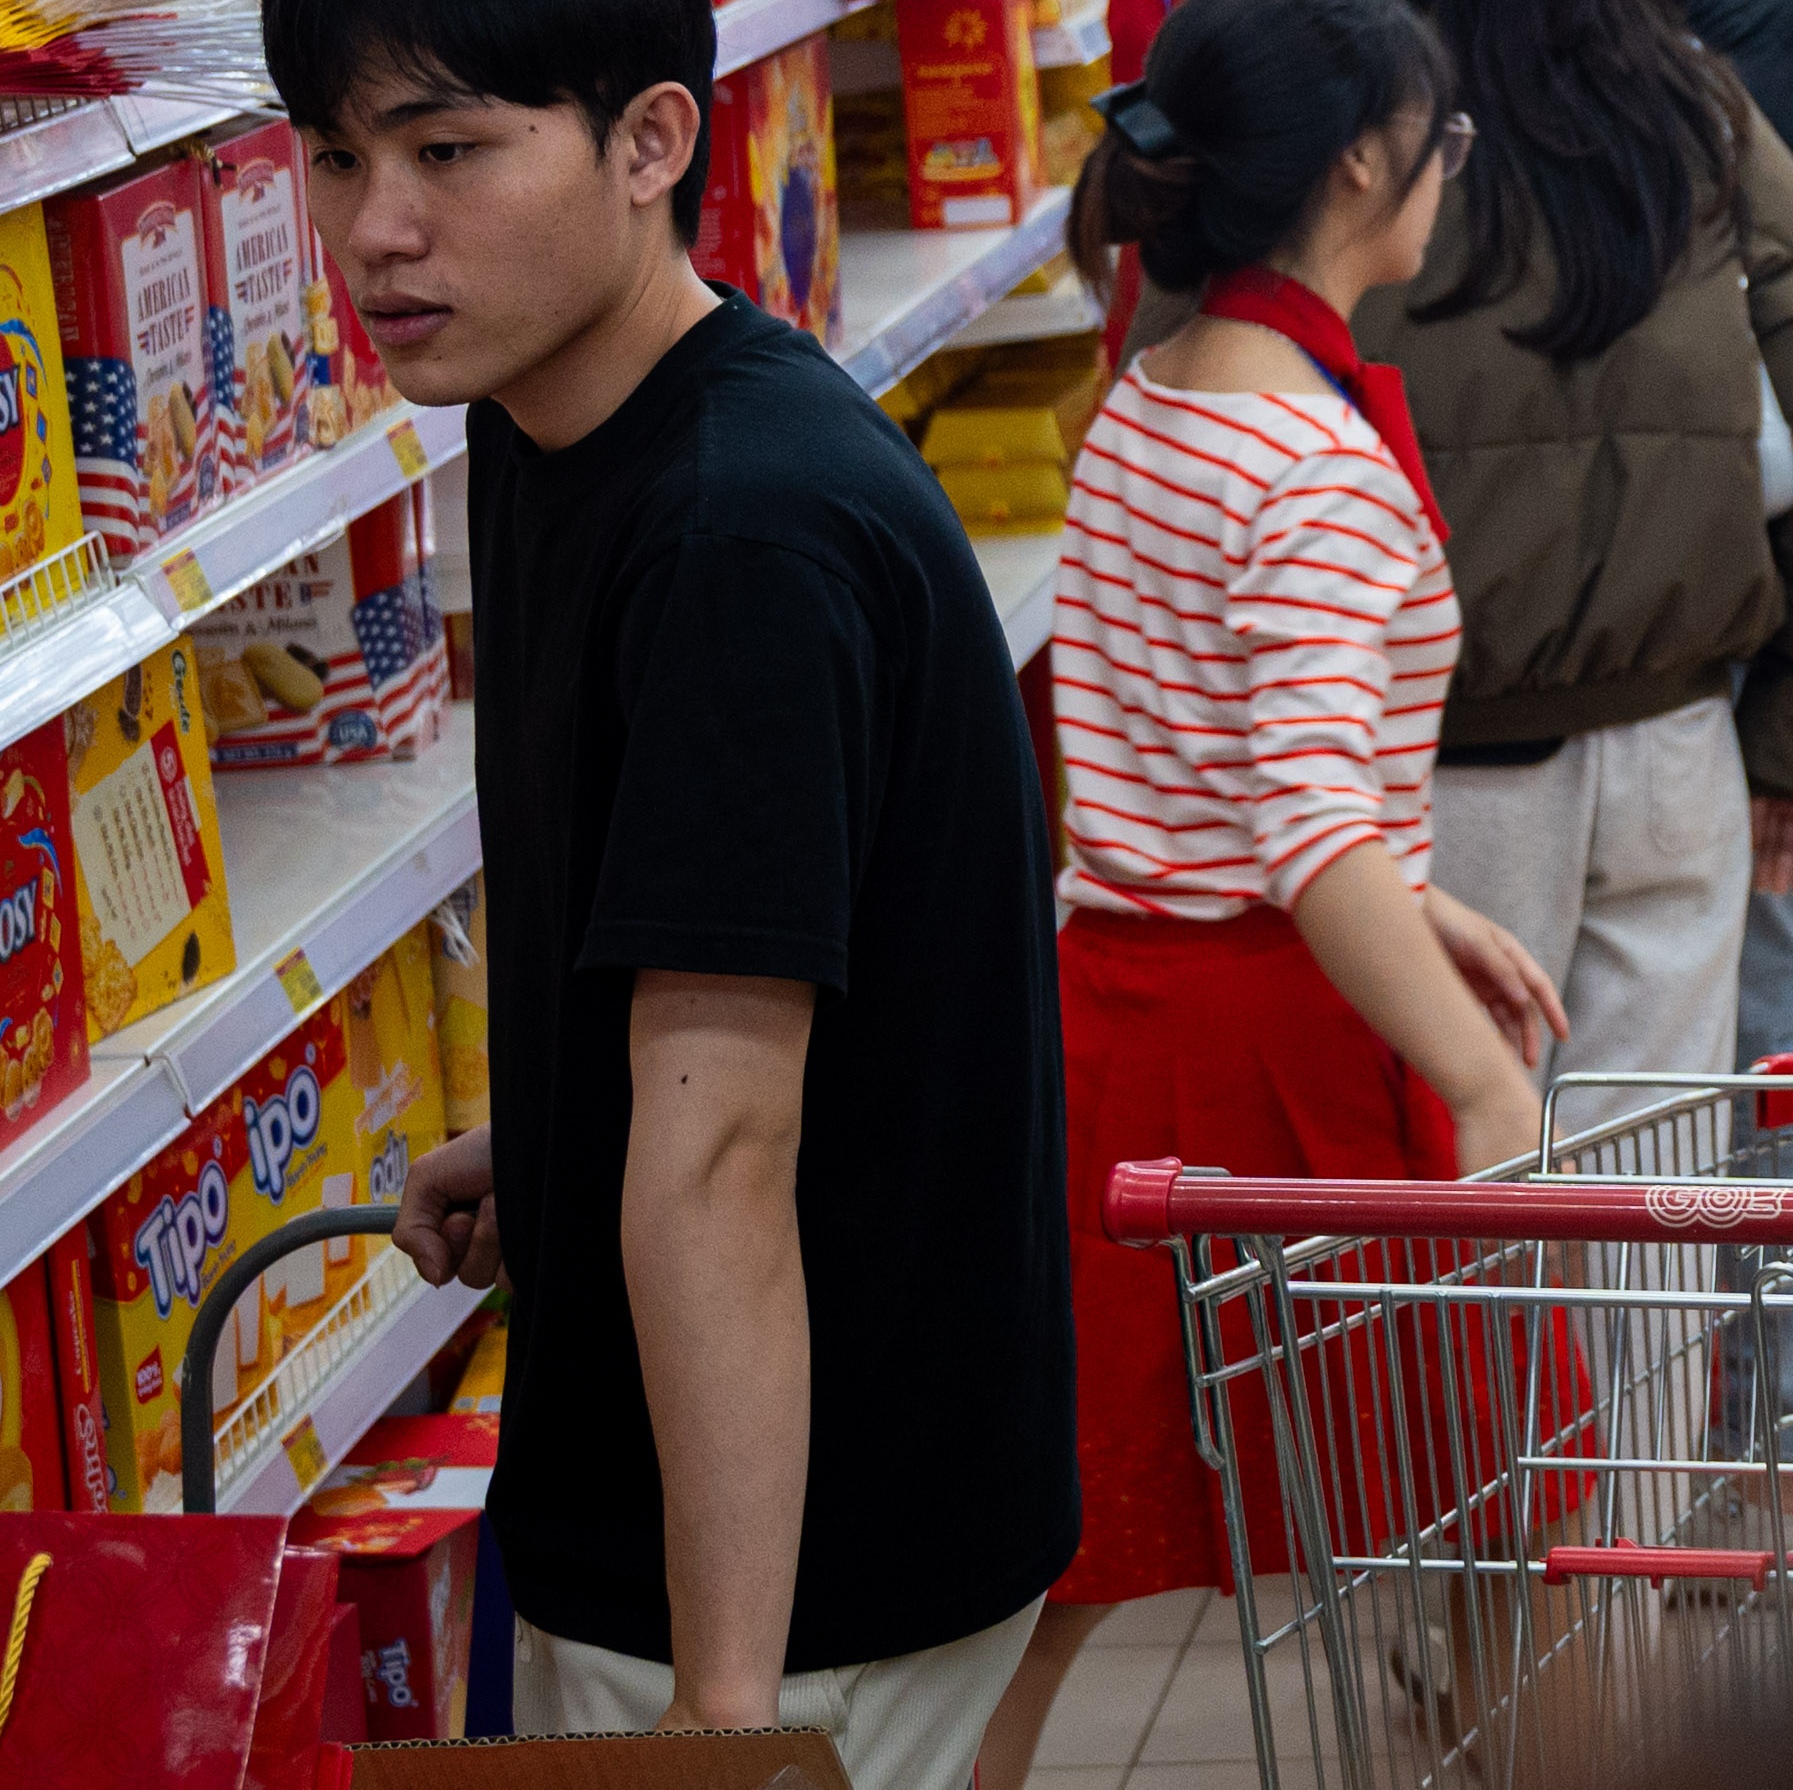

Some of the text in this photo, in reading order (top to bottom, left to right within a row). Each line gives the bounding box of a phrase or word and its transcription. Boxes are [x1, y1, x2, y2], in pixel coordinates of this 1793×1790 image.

[236, 223, 288, 272] AMERICAN
[138, 268, 190, 324] AMERICAN
[247, 262, 286, 304] TASTE
[151, 311, 186, 356] TASTE
[0, 364, 20, 435] SY
[0, 878, 38, 963] OSY
[243, 1064, 321, 1206] ipo
[134, 1159, 229, 1319] Tipo
[376, 1637, 411, 1707] Tipo
